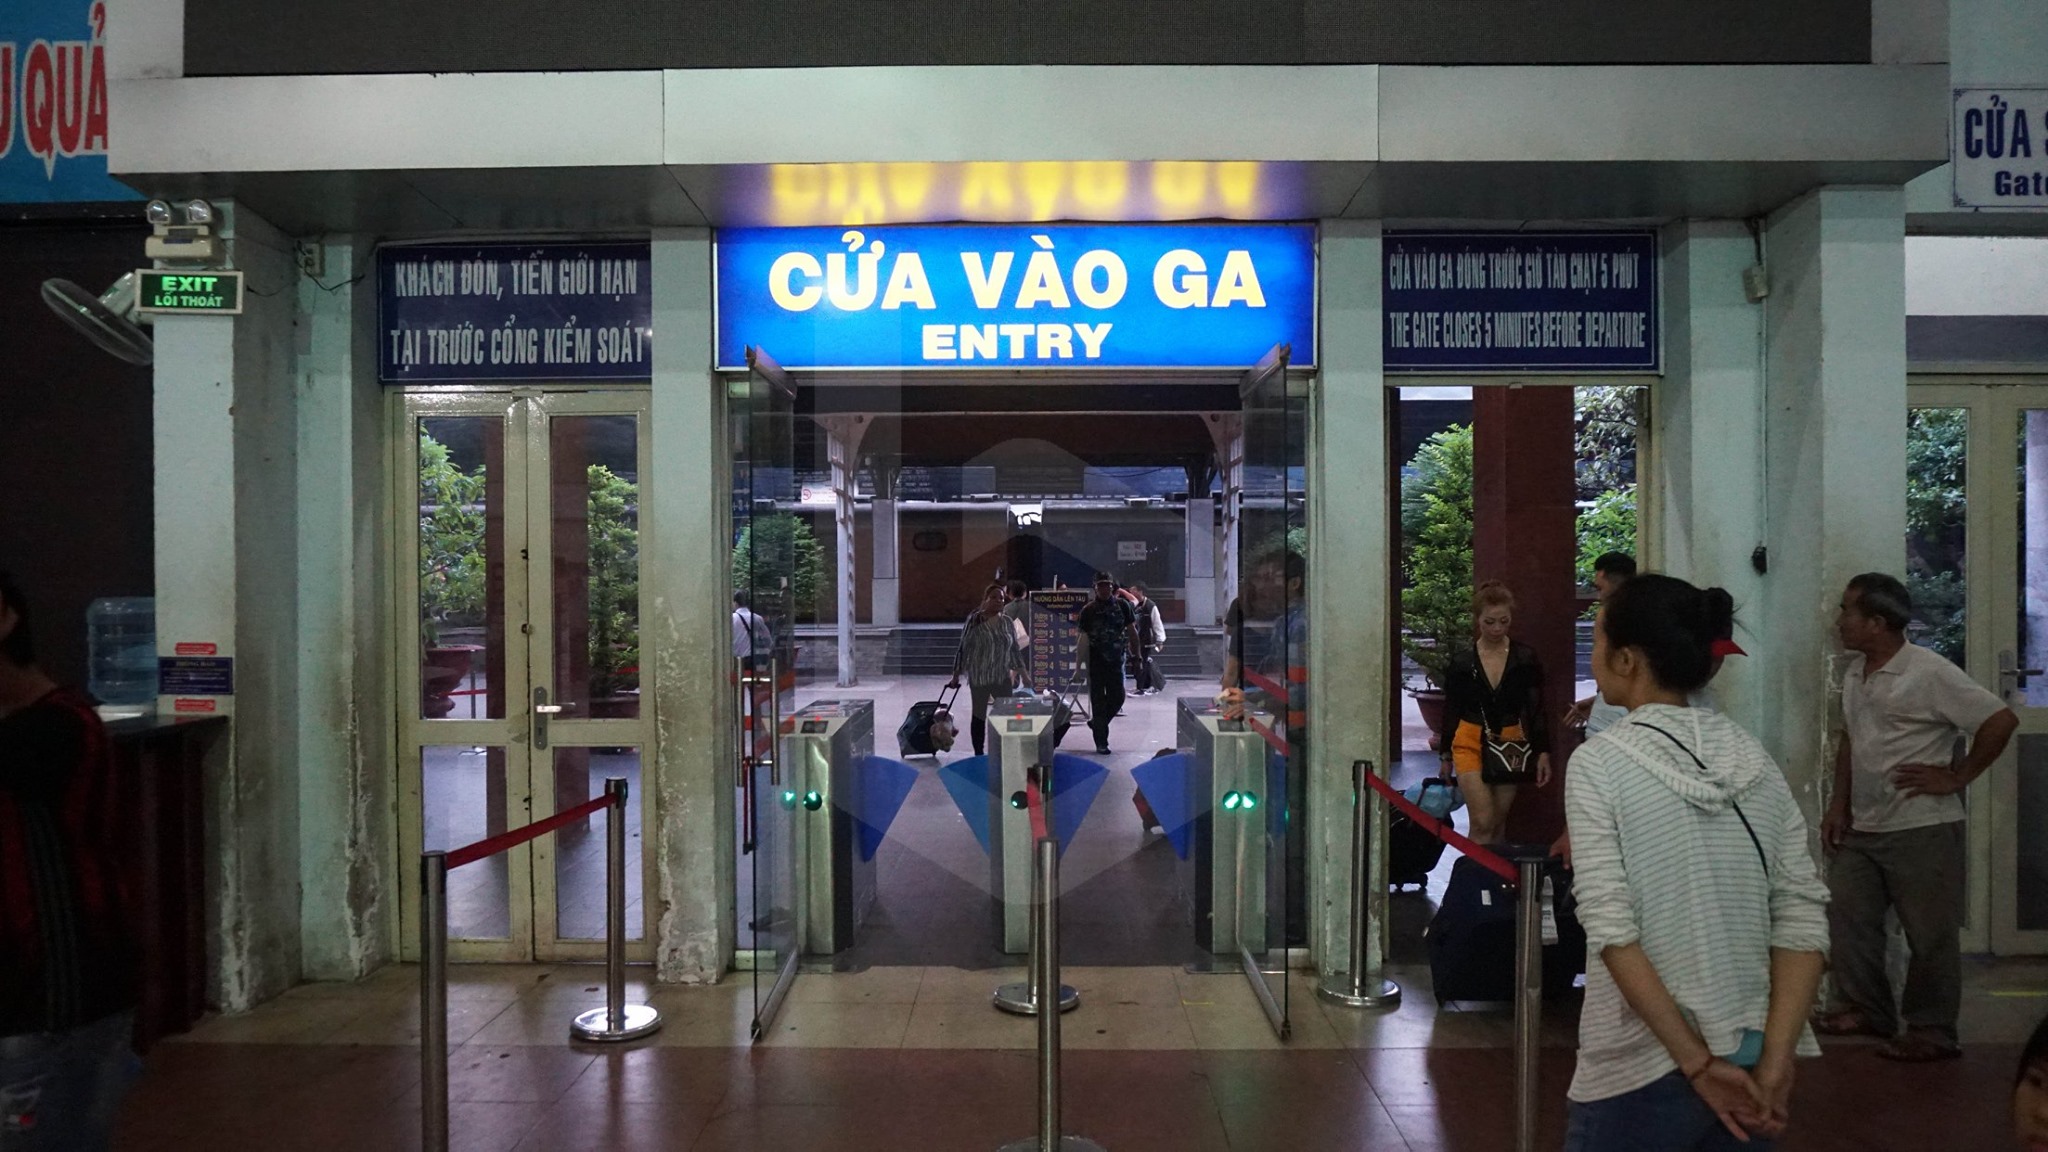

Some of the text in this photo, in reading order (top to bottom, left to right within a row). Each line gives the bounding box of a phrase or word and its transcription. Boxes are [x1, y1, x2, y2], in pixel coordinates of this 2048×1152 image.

[1964, 94, 2032, 159] CỬA
[1995, 170, 2048, 196] Gat
[162, 276, 218, 292] EXIT
[395, 250, 637, 301] KHÁCH ĐÓN, TIỄN GIỚI HẠN
[768, 231, 1267, 311] CỬA VÀO GA
[1390, 243, 1639, 295] CỬA VÀO GA ĐÓNG TRƯỚC GIỜ TÀU CHẠY 5 PHÚT
[155, 290, 223, 307] LỖI THOÁT
[391, 314, 645, 371] TẠI TRƯỚC CỔNG KIỂM SOÁT
[922, 323, 1113, 360] ENTRY
[1390, 311, 1646, 348] THE GATE CLOSES 5 MINUTES BEFORE DEPARTURE
